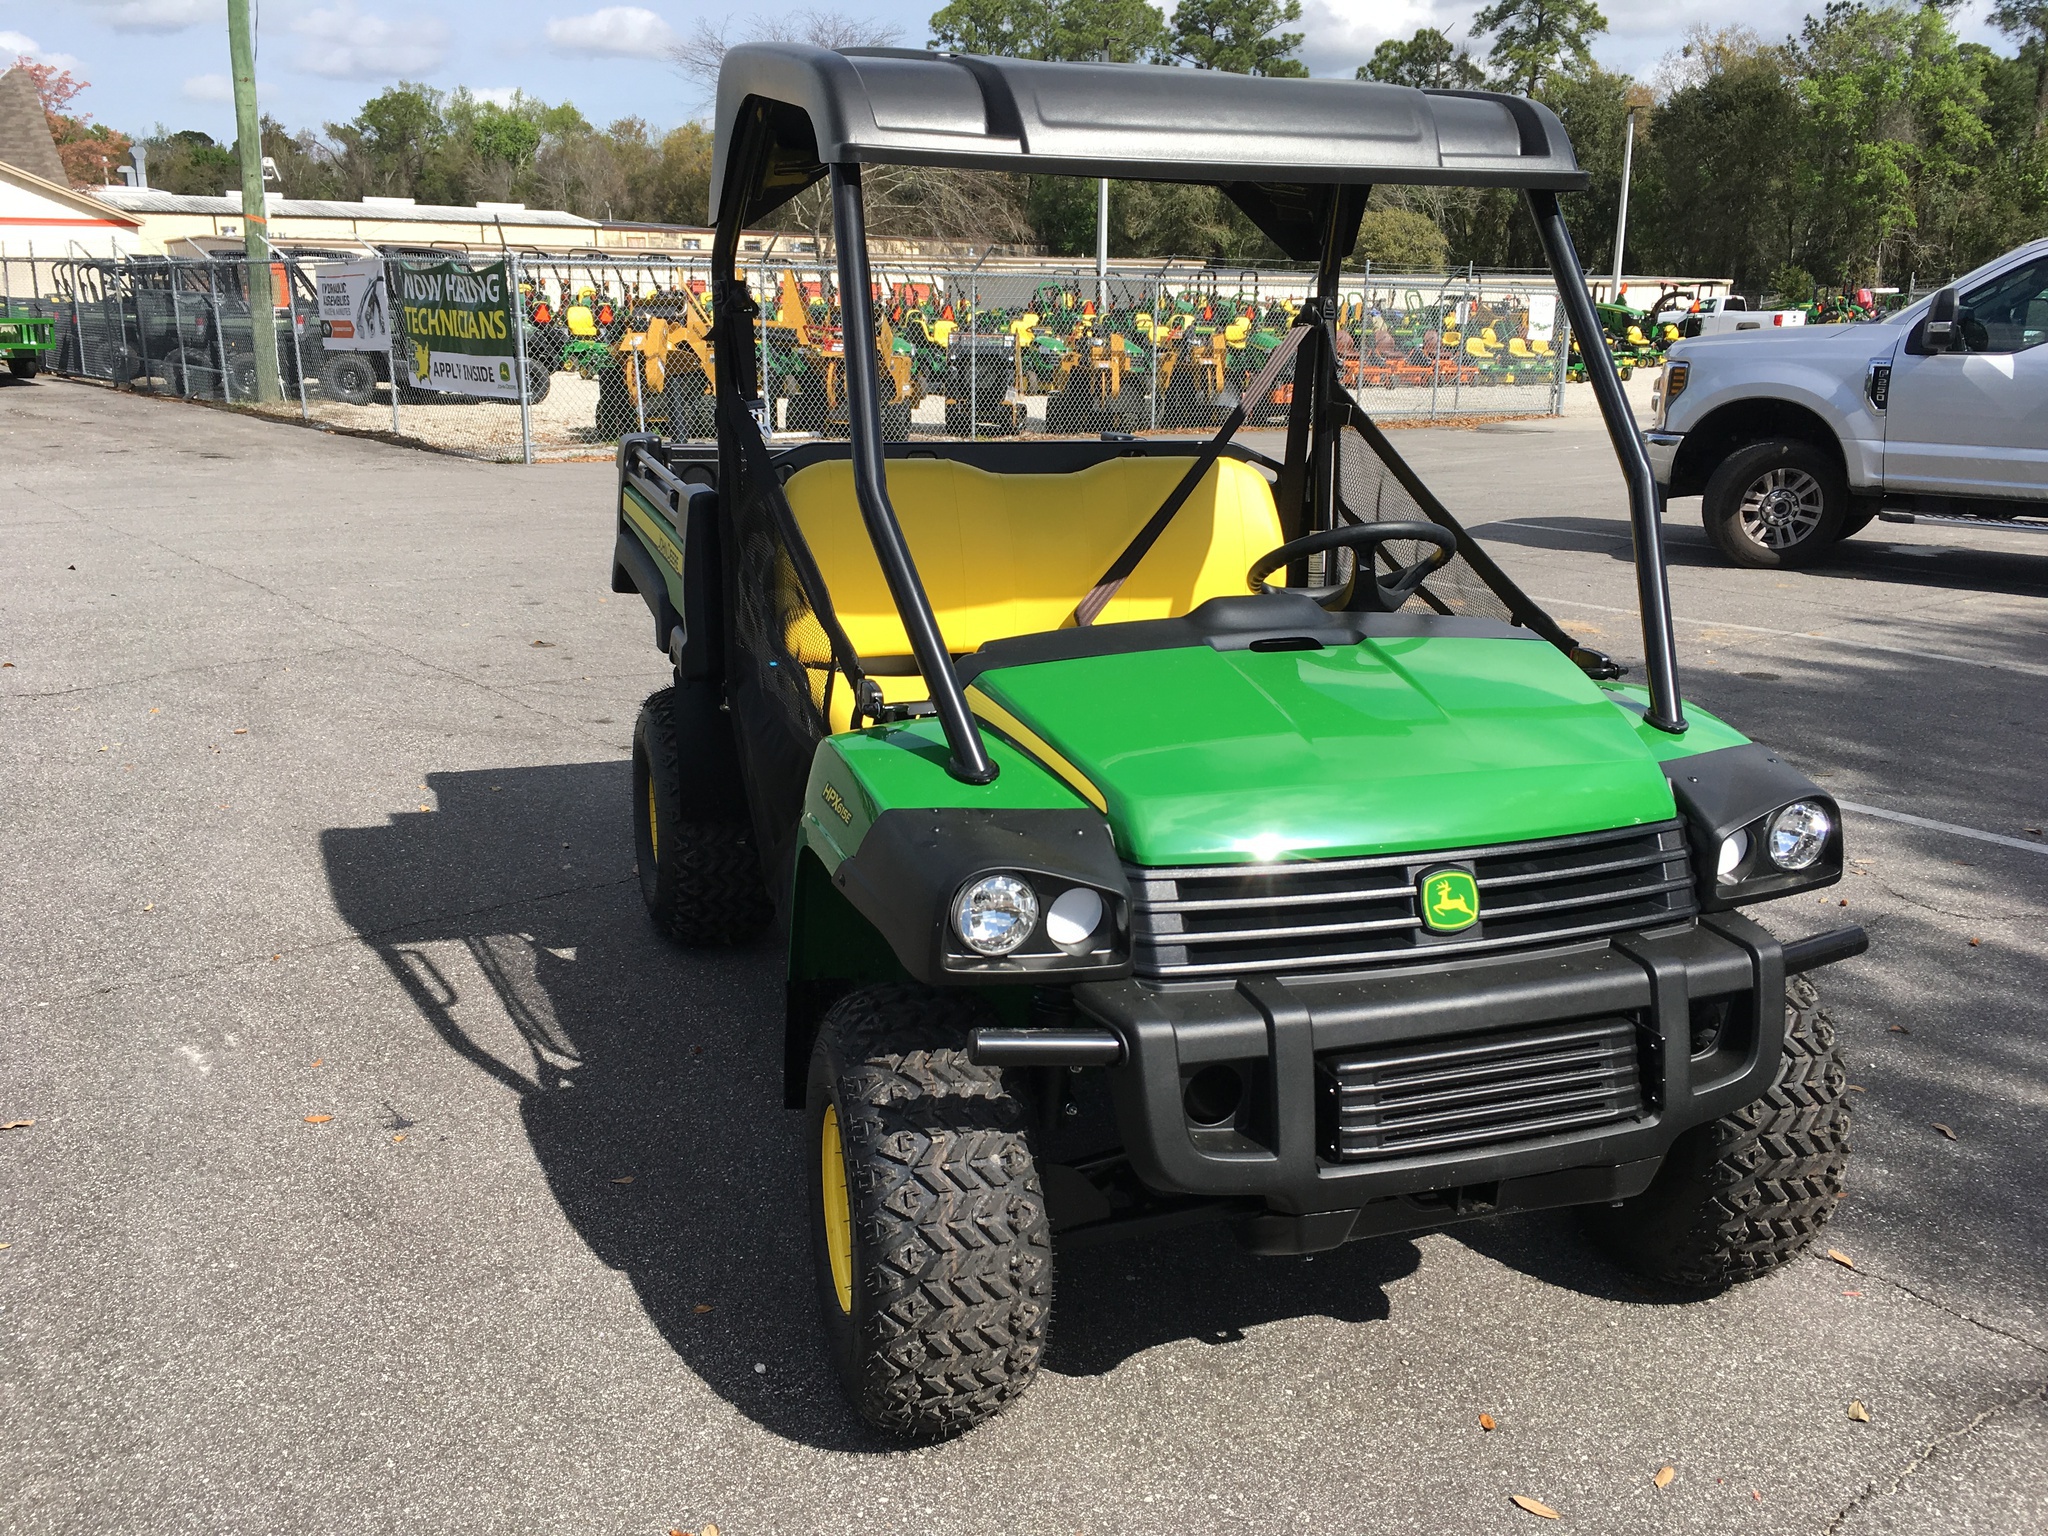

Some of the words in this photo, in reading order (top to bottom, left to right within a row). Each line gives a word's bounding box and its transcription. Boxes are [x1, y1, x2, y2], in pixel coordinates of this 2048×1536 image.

[404, 273, 442, 300] NOW
[445, 273, 500, 303] HIRING
[404, 306, 507, 339] TECHNICIANS
[433, 361, 462, 379] APPLY
[463, 364, 495, 383] INSIDE
[822, 783, 852, 824] HPX615E
